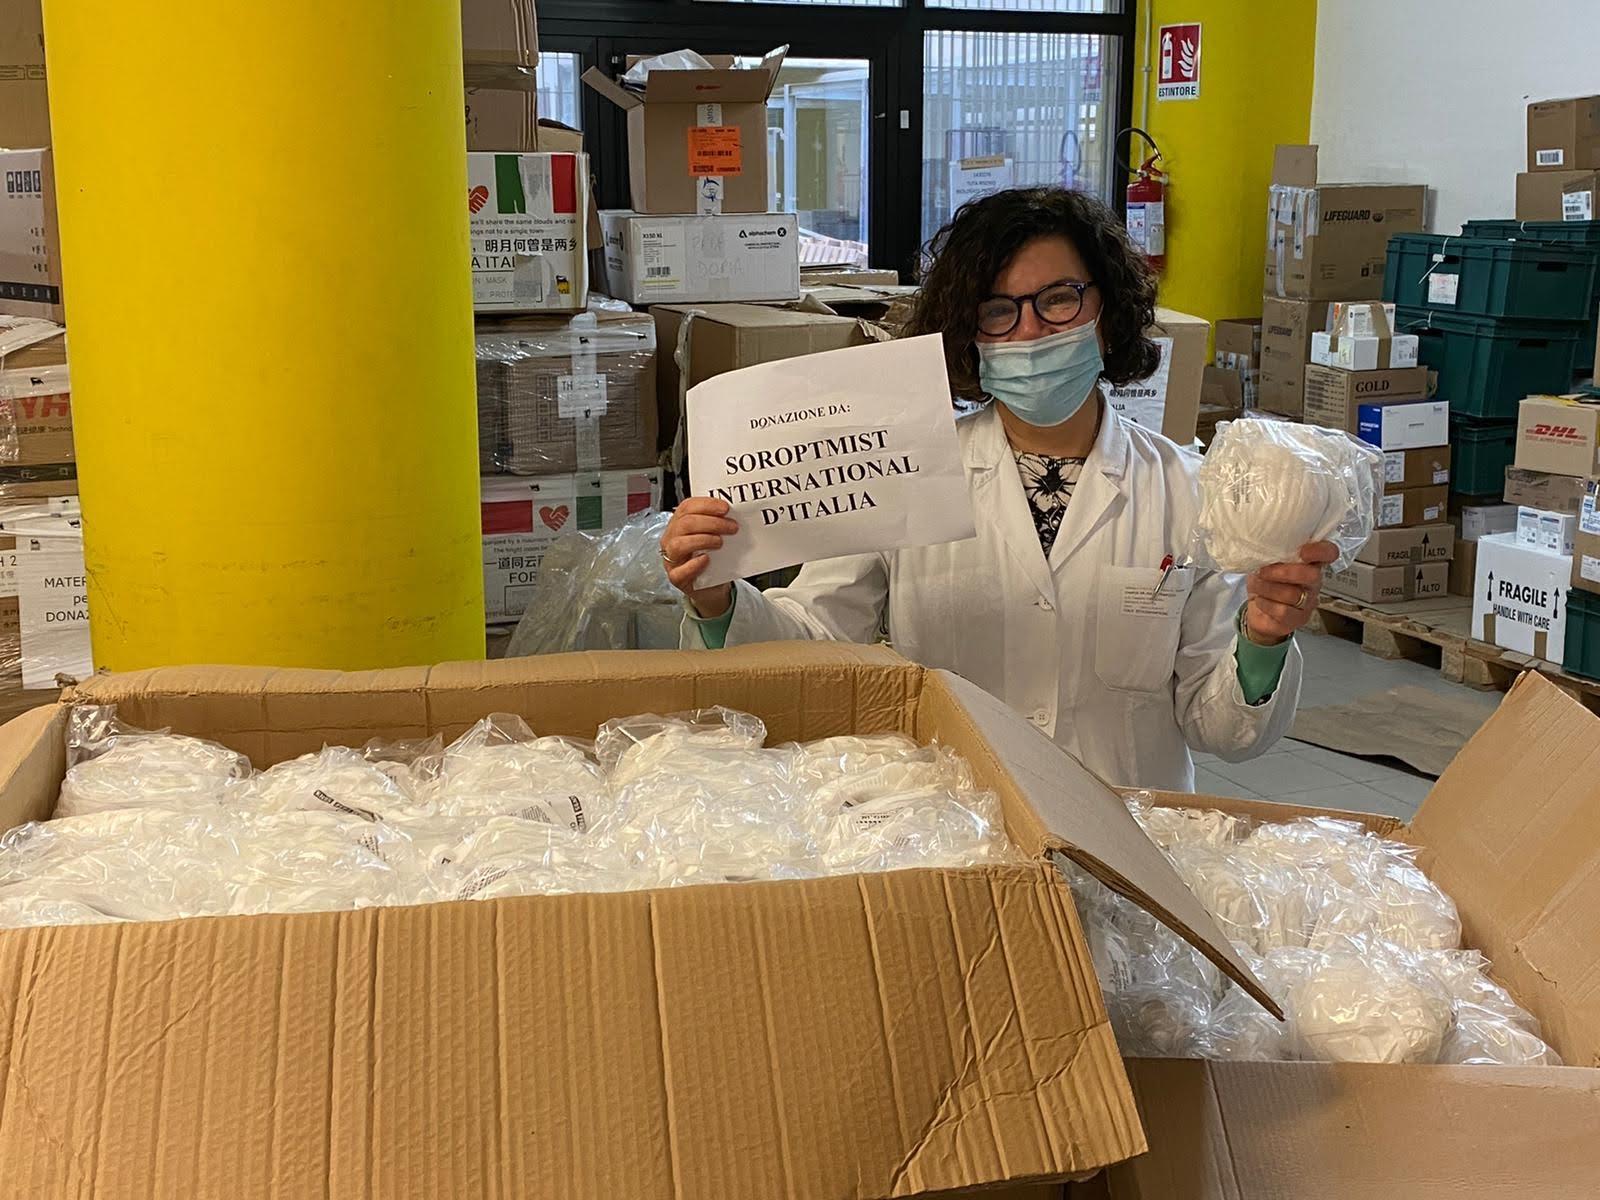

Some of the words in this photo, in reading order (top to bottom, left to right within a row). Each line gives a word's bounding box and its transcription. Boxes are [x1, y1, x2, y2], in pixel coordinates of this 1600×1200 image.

[1159, 86, 1196, 97] ESTINTORE
[1324, 210, 1370, 221] LIFEGUARD
[1355, 380, 1390, 393] GOLD
[750, 406, 826, 430] DONAZIONE
[829, 403, 851, 416] DA:
[1535, 424, 1578, 439] DHL
[725, 430, 889, 475] SOROPTMIST
[709, 455, 920, 505] INTERNATIONAL
[761, 490, 877, 526] D'ITALIA
[1427, 547, 1446, 557] ALTO
[9, 555, 17, 566] 2
[1421, 583, 1440, 593] ALTO
[1499, 580, 1547, 608] FRAGILE
[1493, 603, 1516, 621] HANDLE
[1517, 610, 1533, 625] WITH
[1534, 615, 1550, 631] CARE
